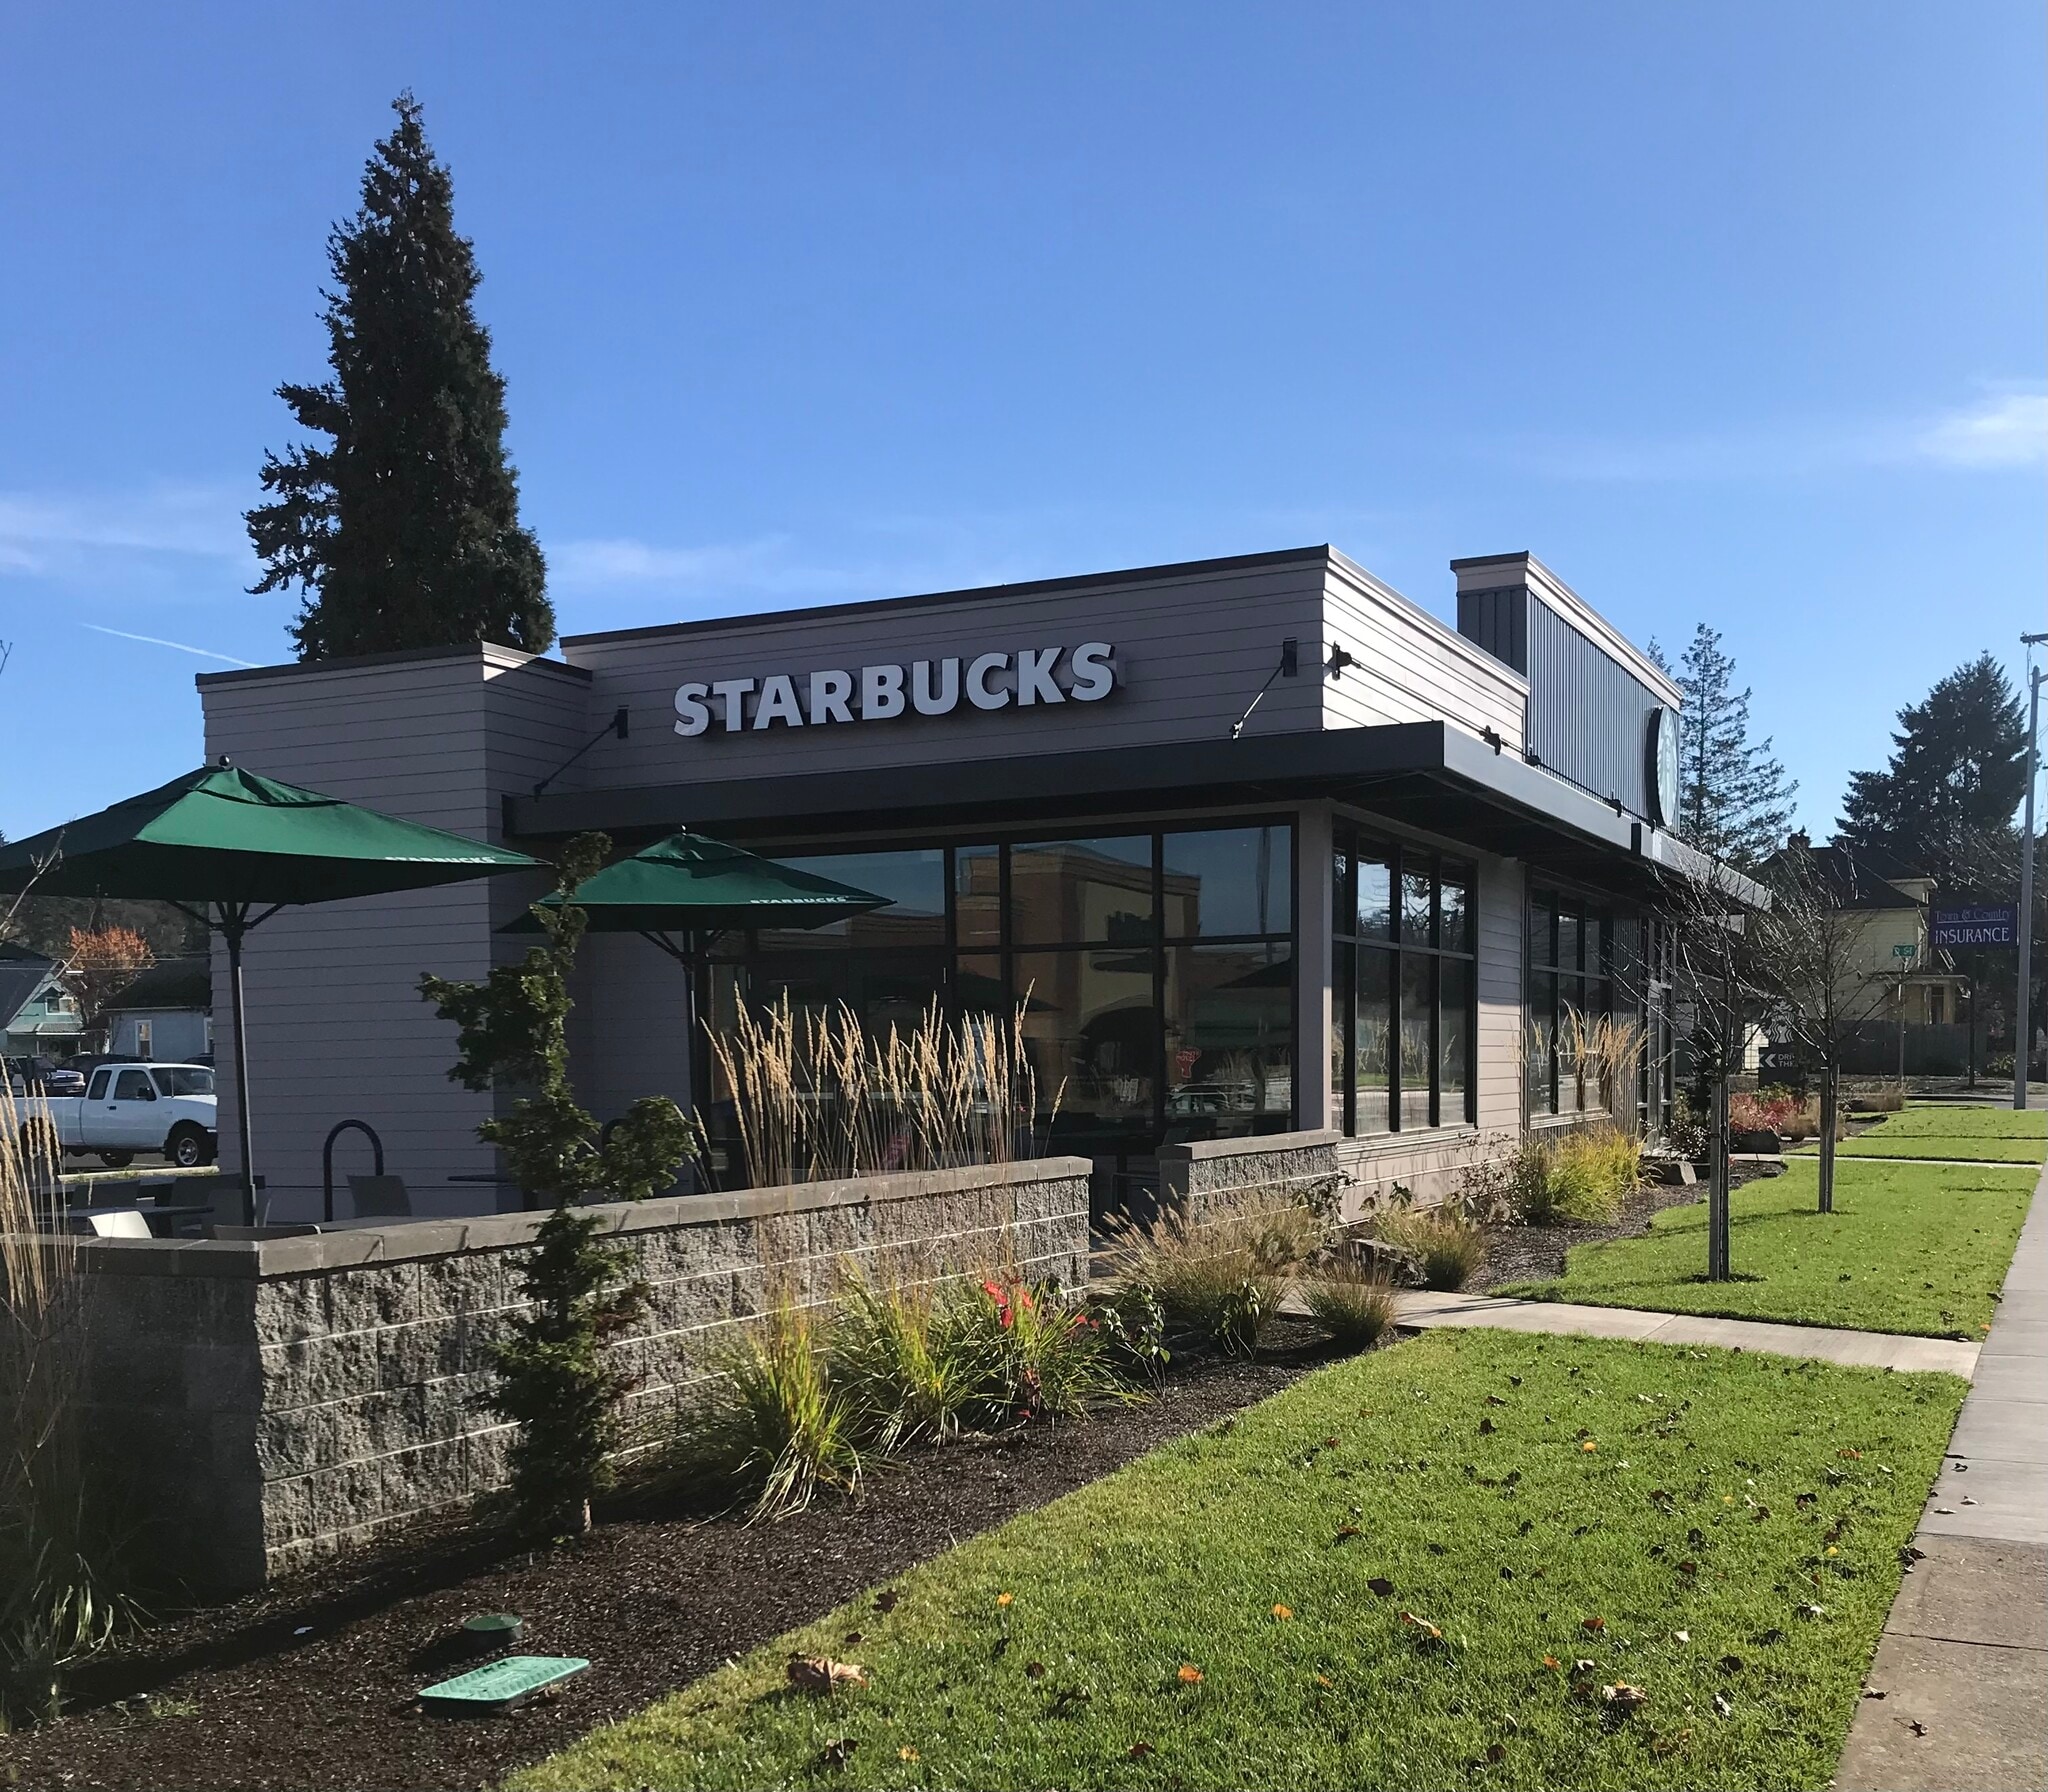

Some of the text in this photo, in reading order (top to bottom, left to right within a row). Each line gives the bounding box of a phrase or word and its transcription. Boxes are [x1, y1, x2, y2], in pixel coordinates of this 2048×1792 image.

[673, 641, 1115, 738] STARBUCKS
[1935, 908, 2010, 922] Town & Country
[1935, 927, 2010, 944] INSURANCE
